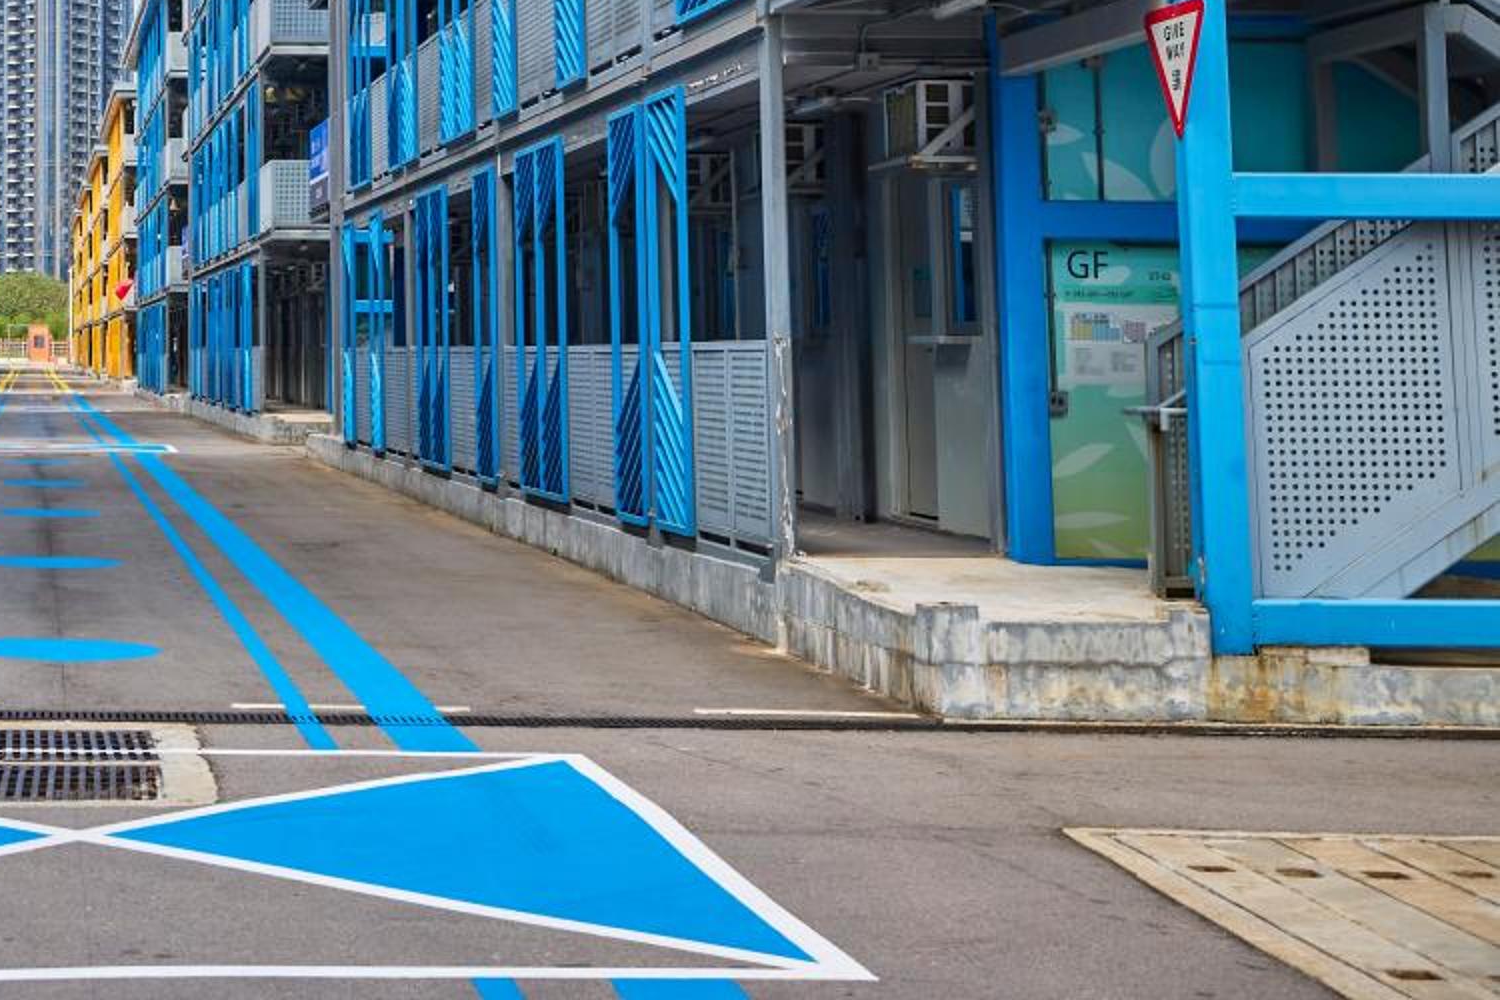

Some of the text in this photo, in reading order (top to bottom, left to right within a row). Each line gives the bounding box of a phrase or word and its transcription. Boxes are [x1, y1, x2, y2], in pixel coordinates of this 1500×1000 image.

[1163, 21, 1185, 41] GIVE
[1166, 42, 1185, 60] WAY
[1067, 249, 1109, 279] GF
